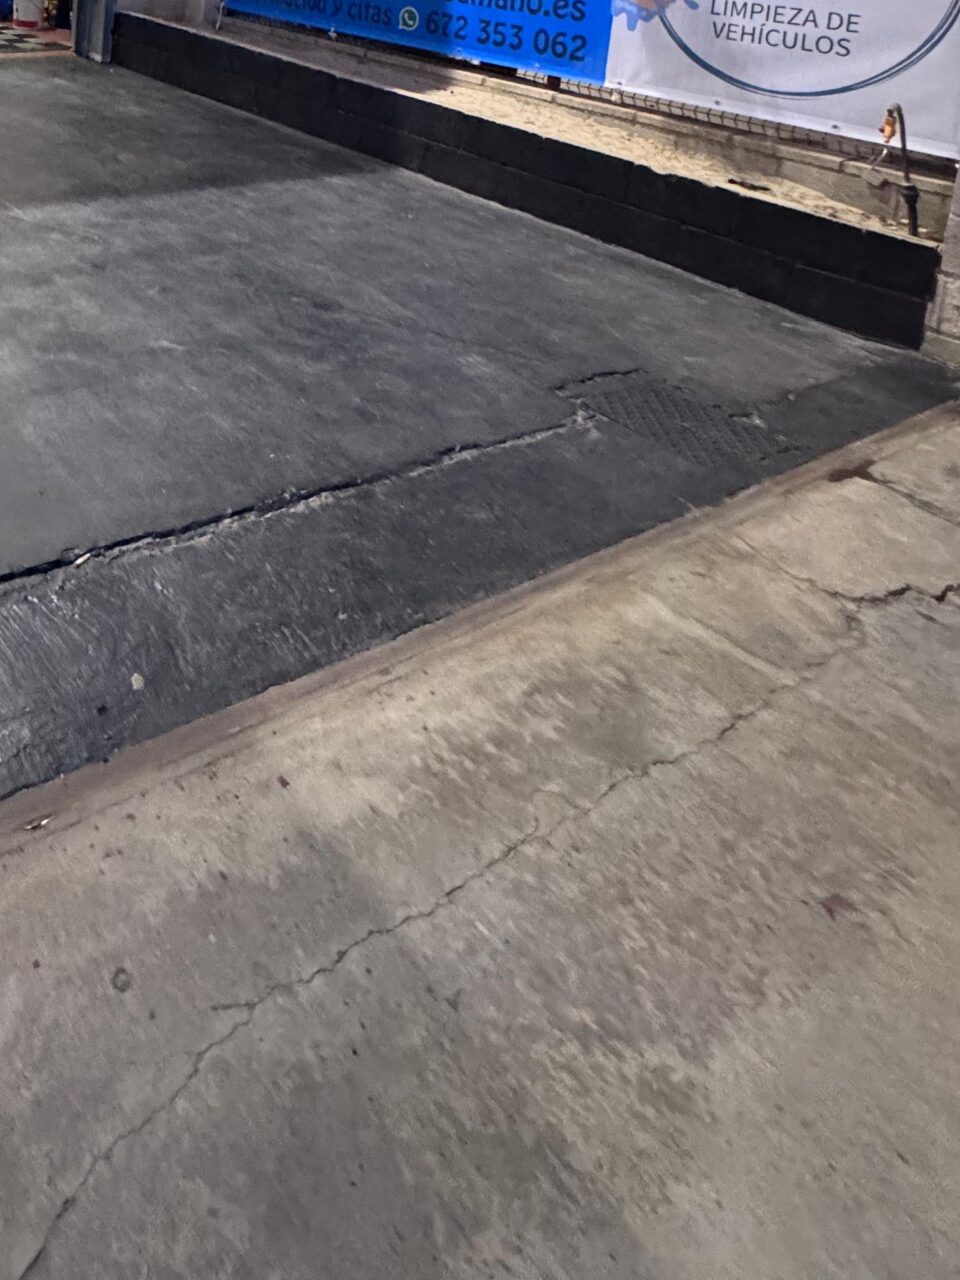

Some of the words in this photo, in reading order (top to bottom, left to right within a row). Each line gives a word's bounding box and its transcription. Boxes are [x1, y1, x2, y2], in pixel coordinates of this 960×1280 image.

[425, 10, 468, 42] 672
[476, 19, 523, 51] 353
[533, 28, 587, 63] 062
[712, 21, 851, 58] VEHÍCULOS
[826, 11, 862, 34] DE
